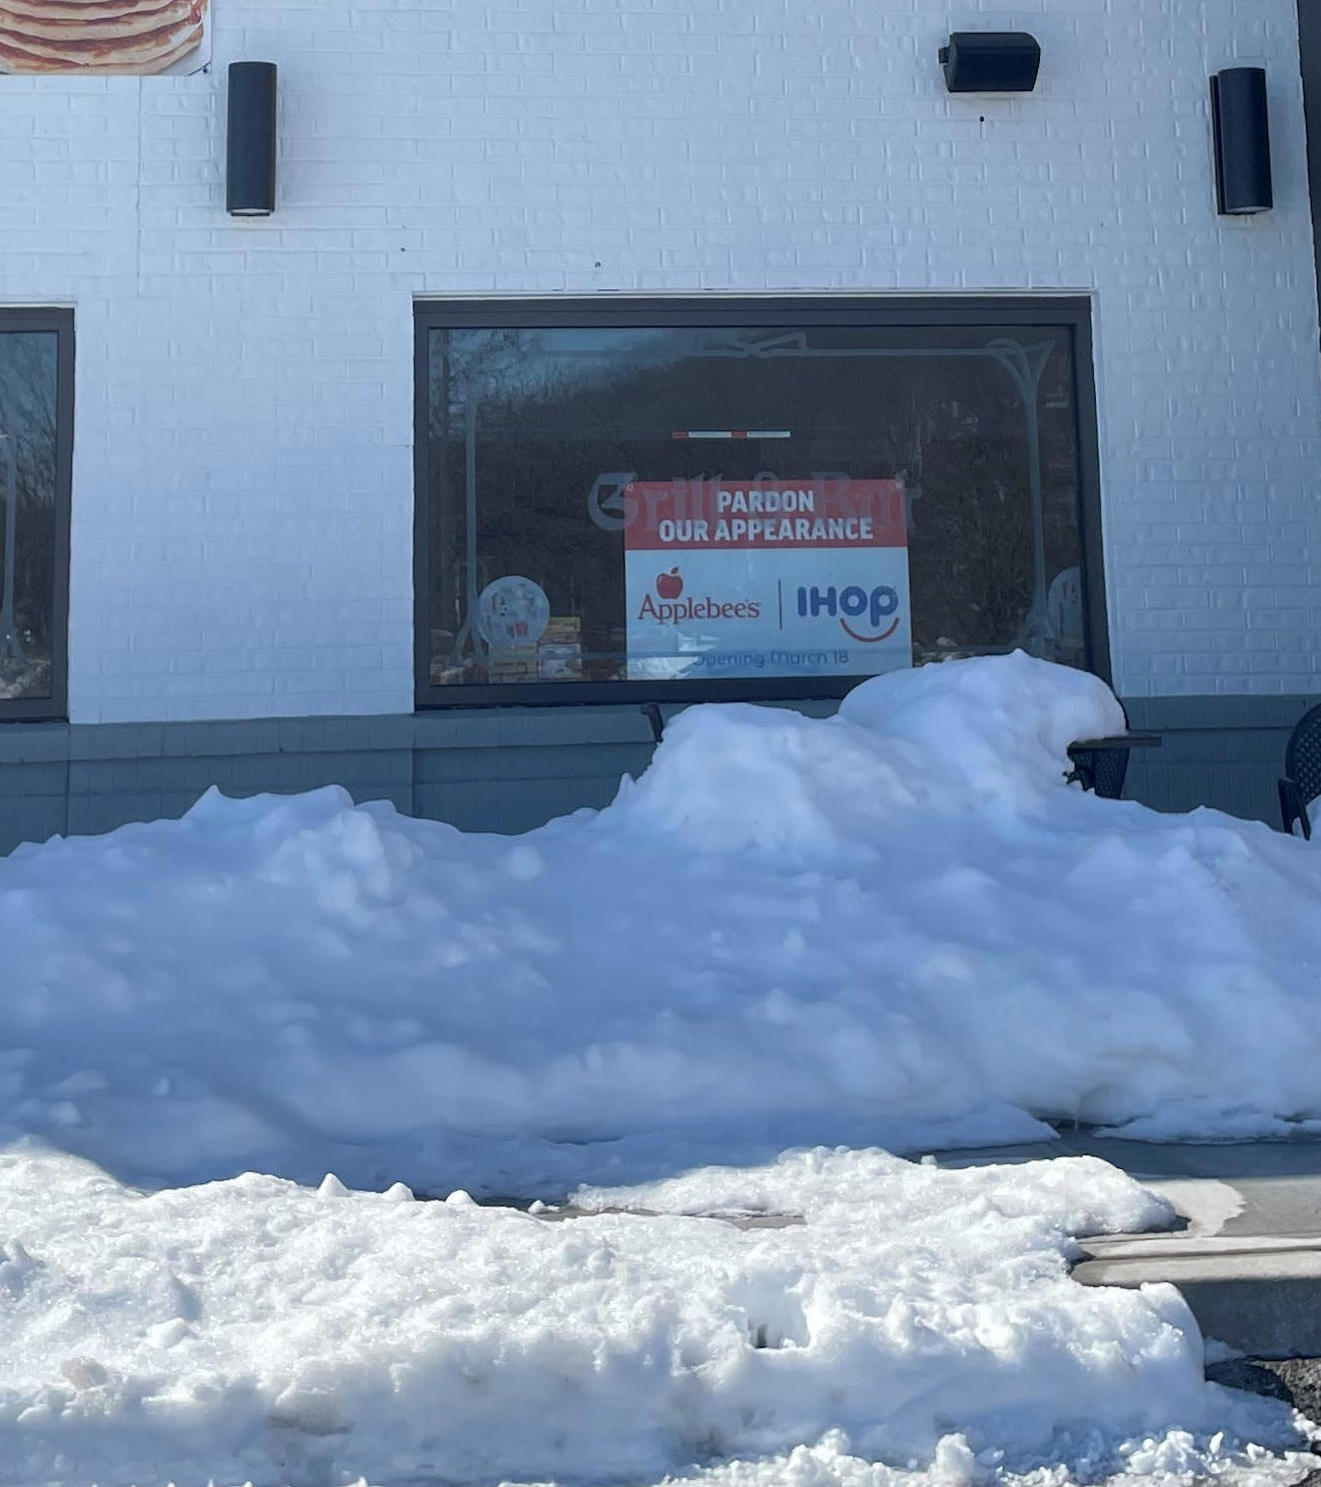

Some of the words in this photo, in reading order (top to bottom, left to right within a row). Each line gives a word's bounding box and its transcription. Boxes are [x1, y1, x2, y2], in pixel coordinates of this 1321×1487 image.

[717, 489, 815, 513] PARDON
[659, 519, 710, 542] OUR
[714, 516, 874, 542] APPEARANCE
[637, 593, 761, 625] Applebee's
[770, 649, 827, 665] March
[832, 649, 849, 664] 18
